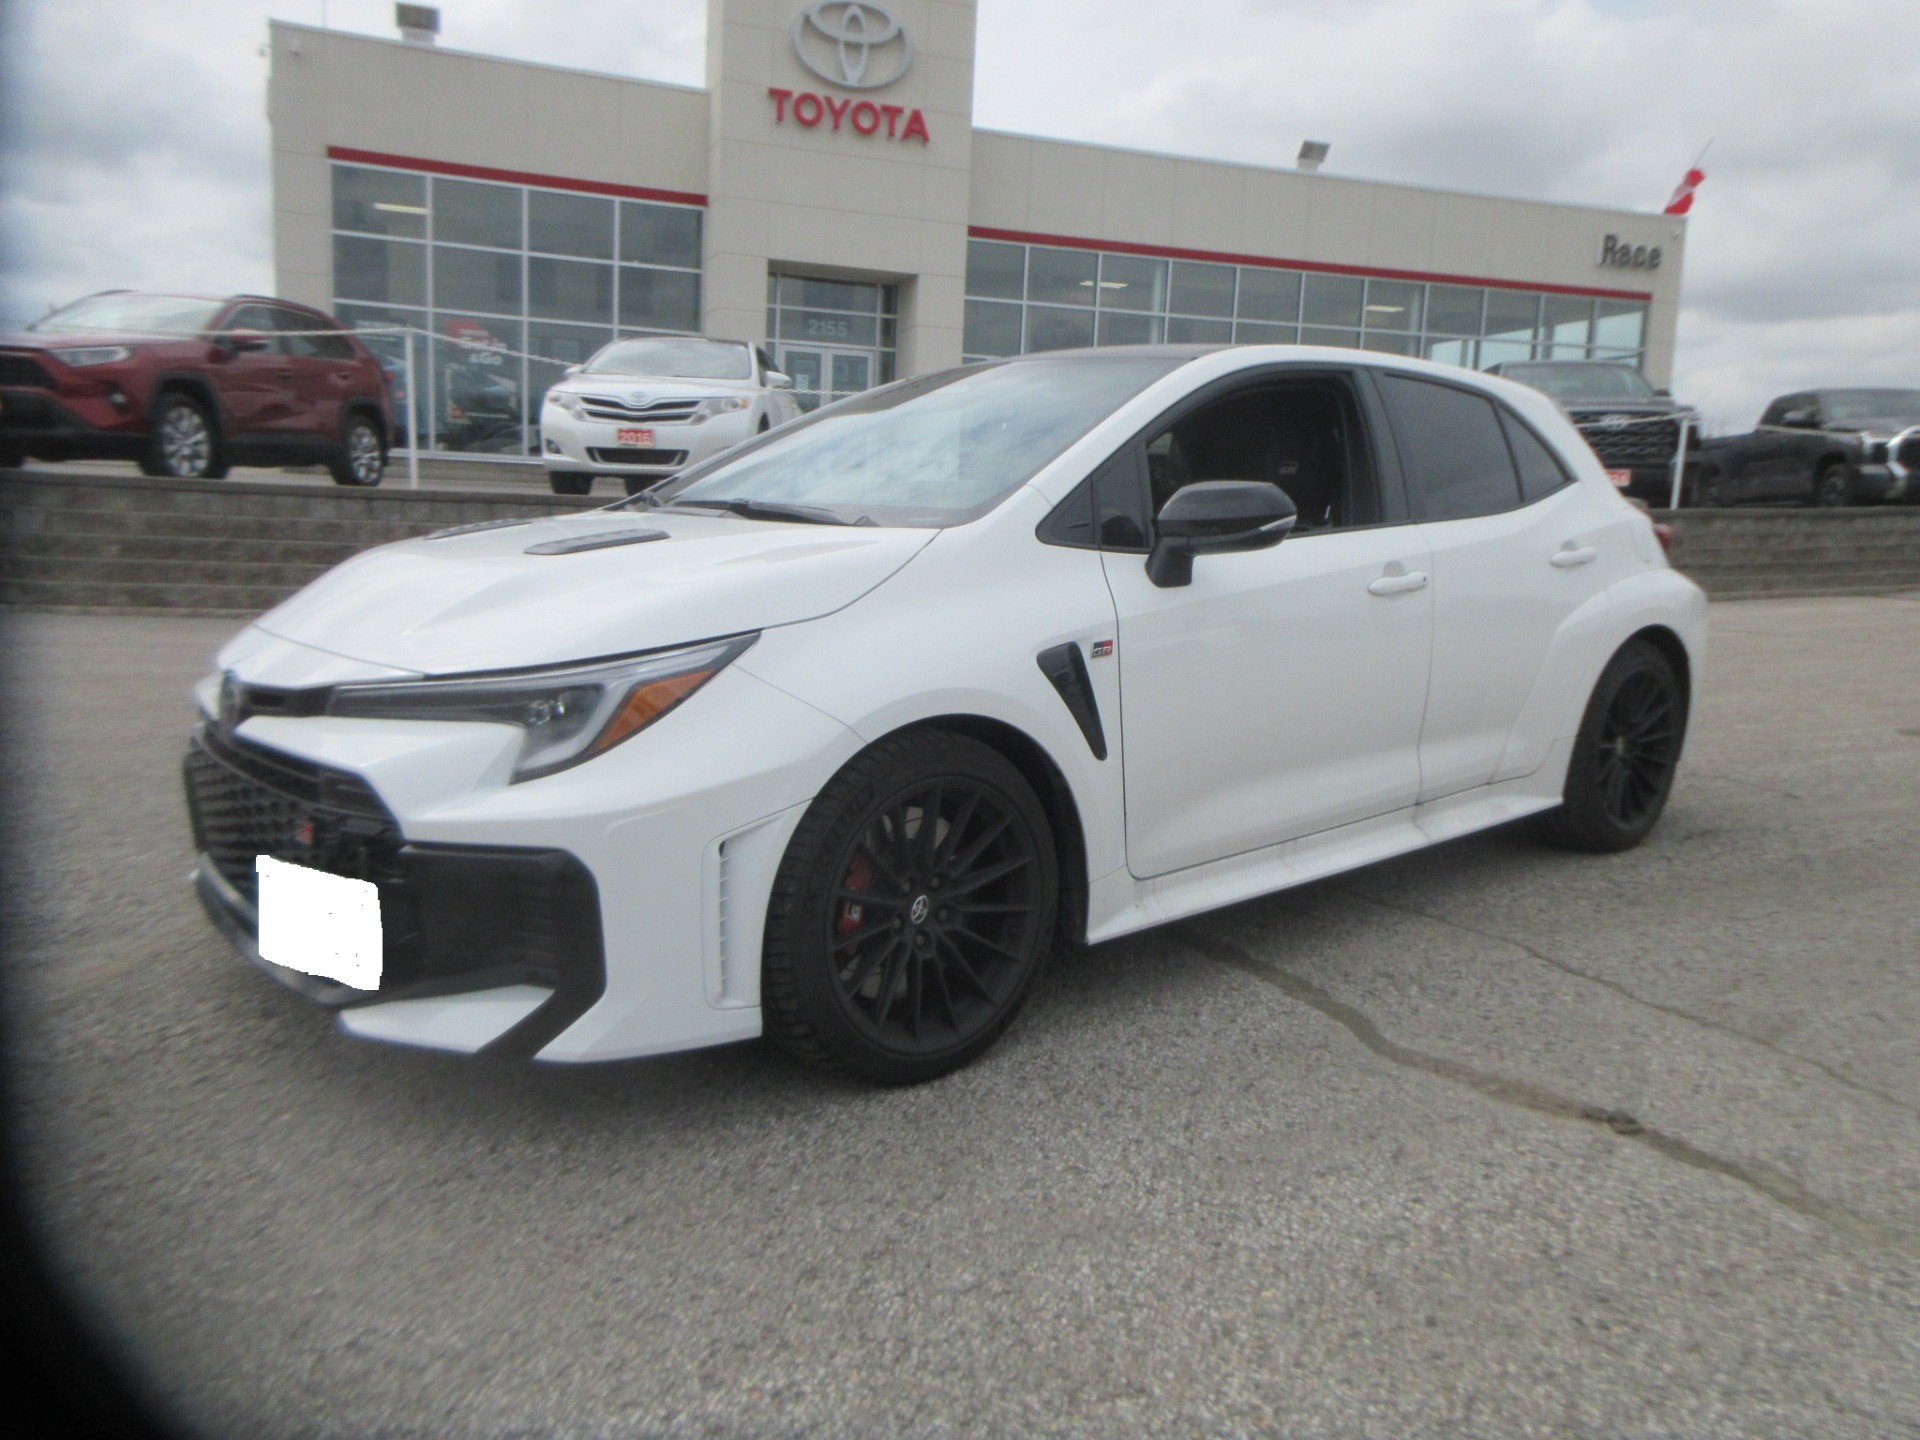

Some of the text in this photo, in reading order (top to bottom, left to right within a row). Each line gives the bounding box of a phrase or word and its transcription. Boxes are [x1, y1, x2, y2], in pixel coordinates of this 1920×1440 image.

[767, 87, 930, 143] TOYOTA
[1601, 233, 1661, 269] Race
[808, 319, 847, 337] 2155
